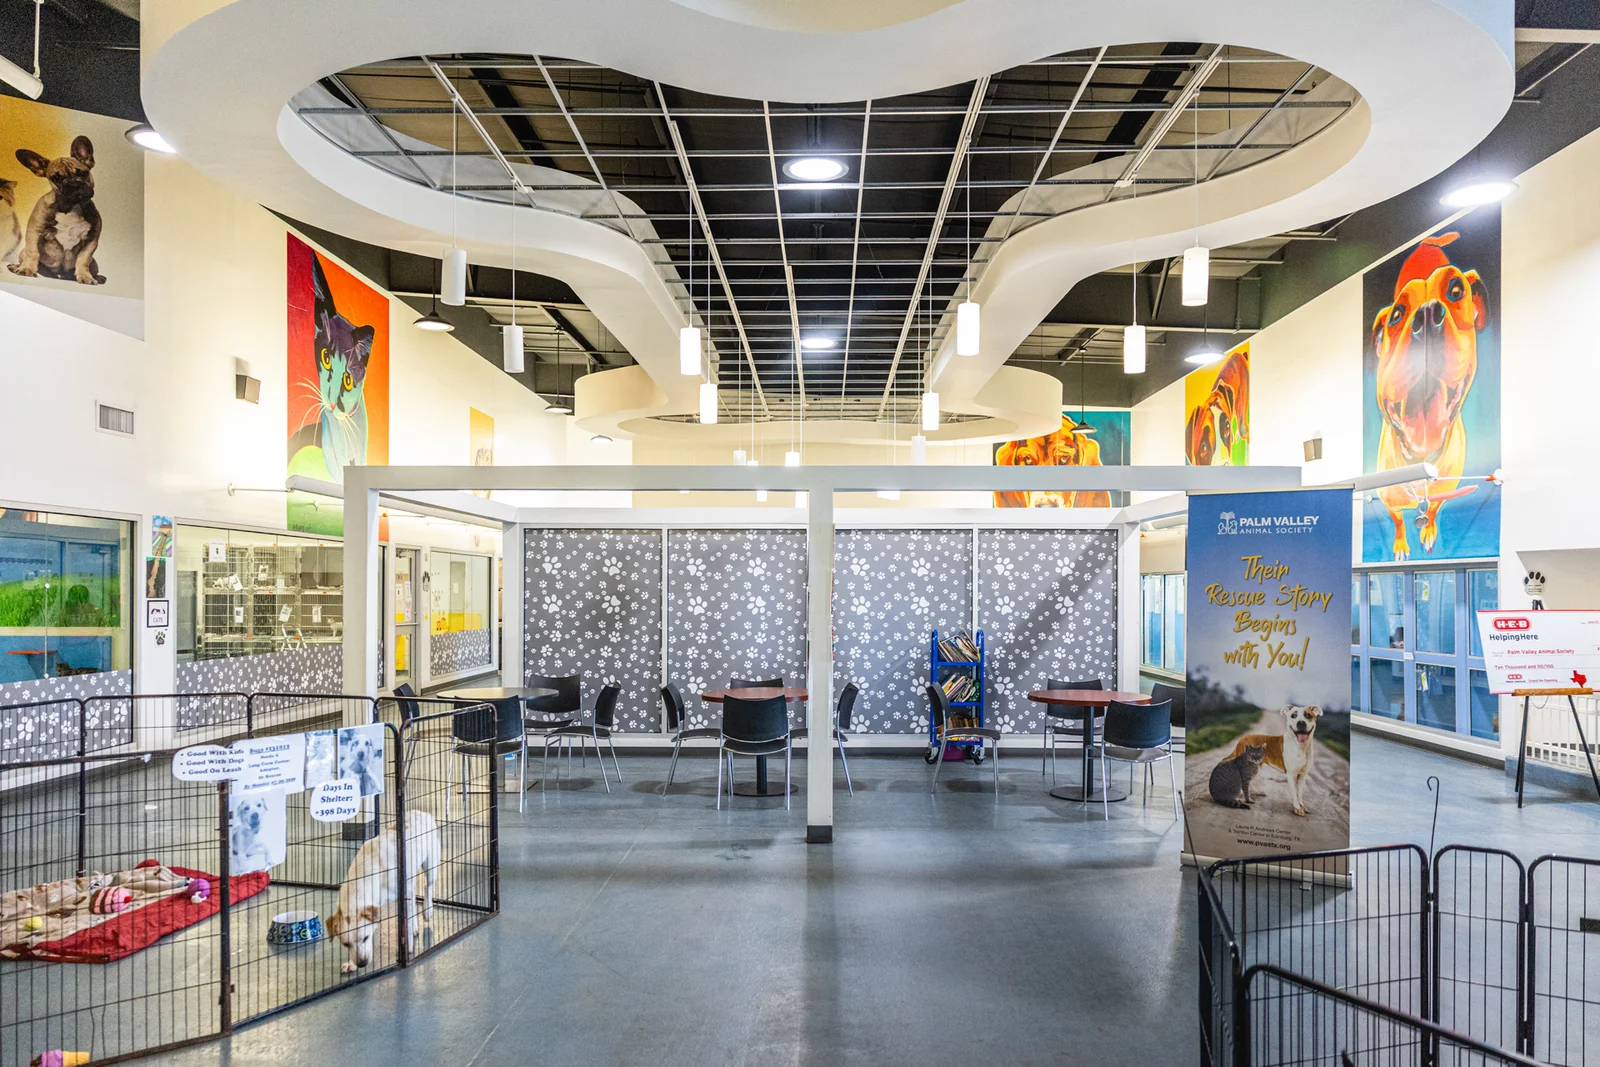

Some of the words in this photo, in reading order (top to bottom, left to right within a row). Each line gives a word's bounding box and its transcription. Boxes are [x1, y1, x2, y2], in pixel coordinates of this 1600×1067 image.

[1240, 517, 1271, 527] PALM
[1273, 516, 1319, 525] VALLEY
[1276, 526, 1313, 534] SOCIETY
[1241, 555, 1290, 584] Their
[1205, 583, 1265, 607] Rescue
[1274, 584, 1333, 612] Story
[1233, 610, 1297, 642] Begins
[1223, 641, 1259, 669] with
[1267, 636, 1310, 671] You!
[323, 784, 342, 792] Days
[320, 795, 353, 803] Shelter:
[336, 807, 356, 815] Days
[1236, 838, 1291, 851] www.pvastx.org
